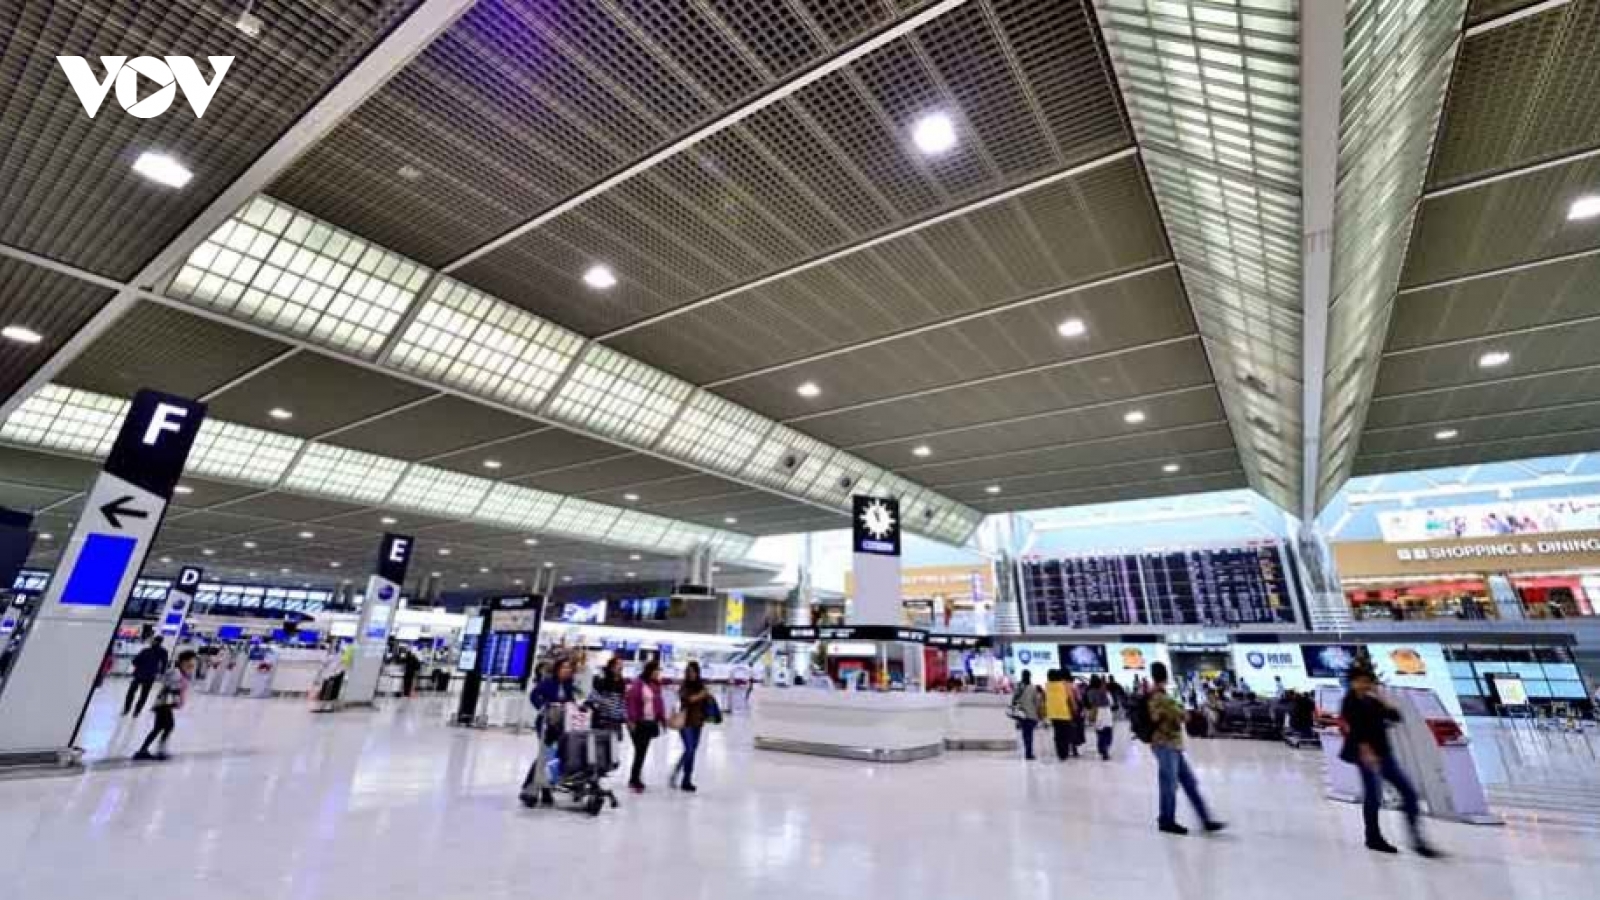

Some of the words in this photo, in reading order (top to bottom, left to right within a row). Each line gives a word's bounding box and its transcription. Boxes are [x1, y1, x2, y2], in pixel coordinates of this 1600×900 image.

[143, 403, 188, 445] F
[389, 539, 409, 562] E
[1429, 543, 1517, 561] SHOPPING
[1521, 542, 1533, 554] &
[1536, 538, 1600, 553] DINING
[181, 569, 199, 585] D
